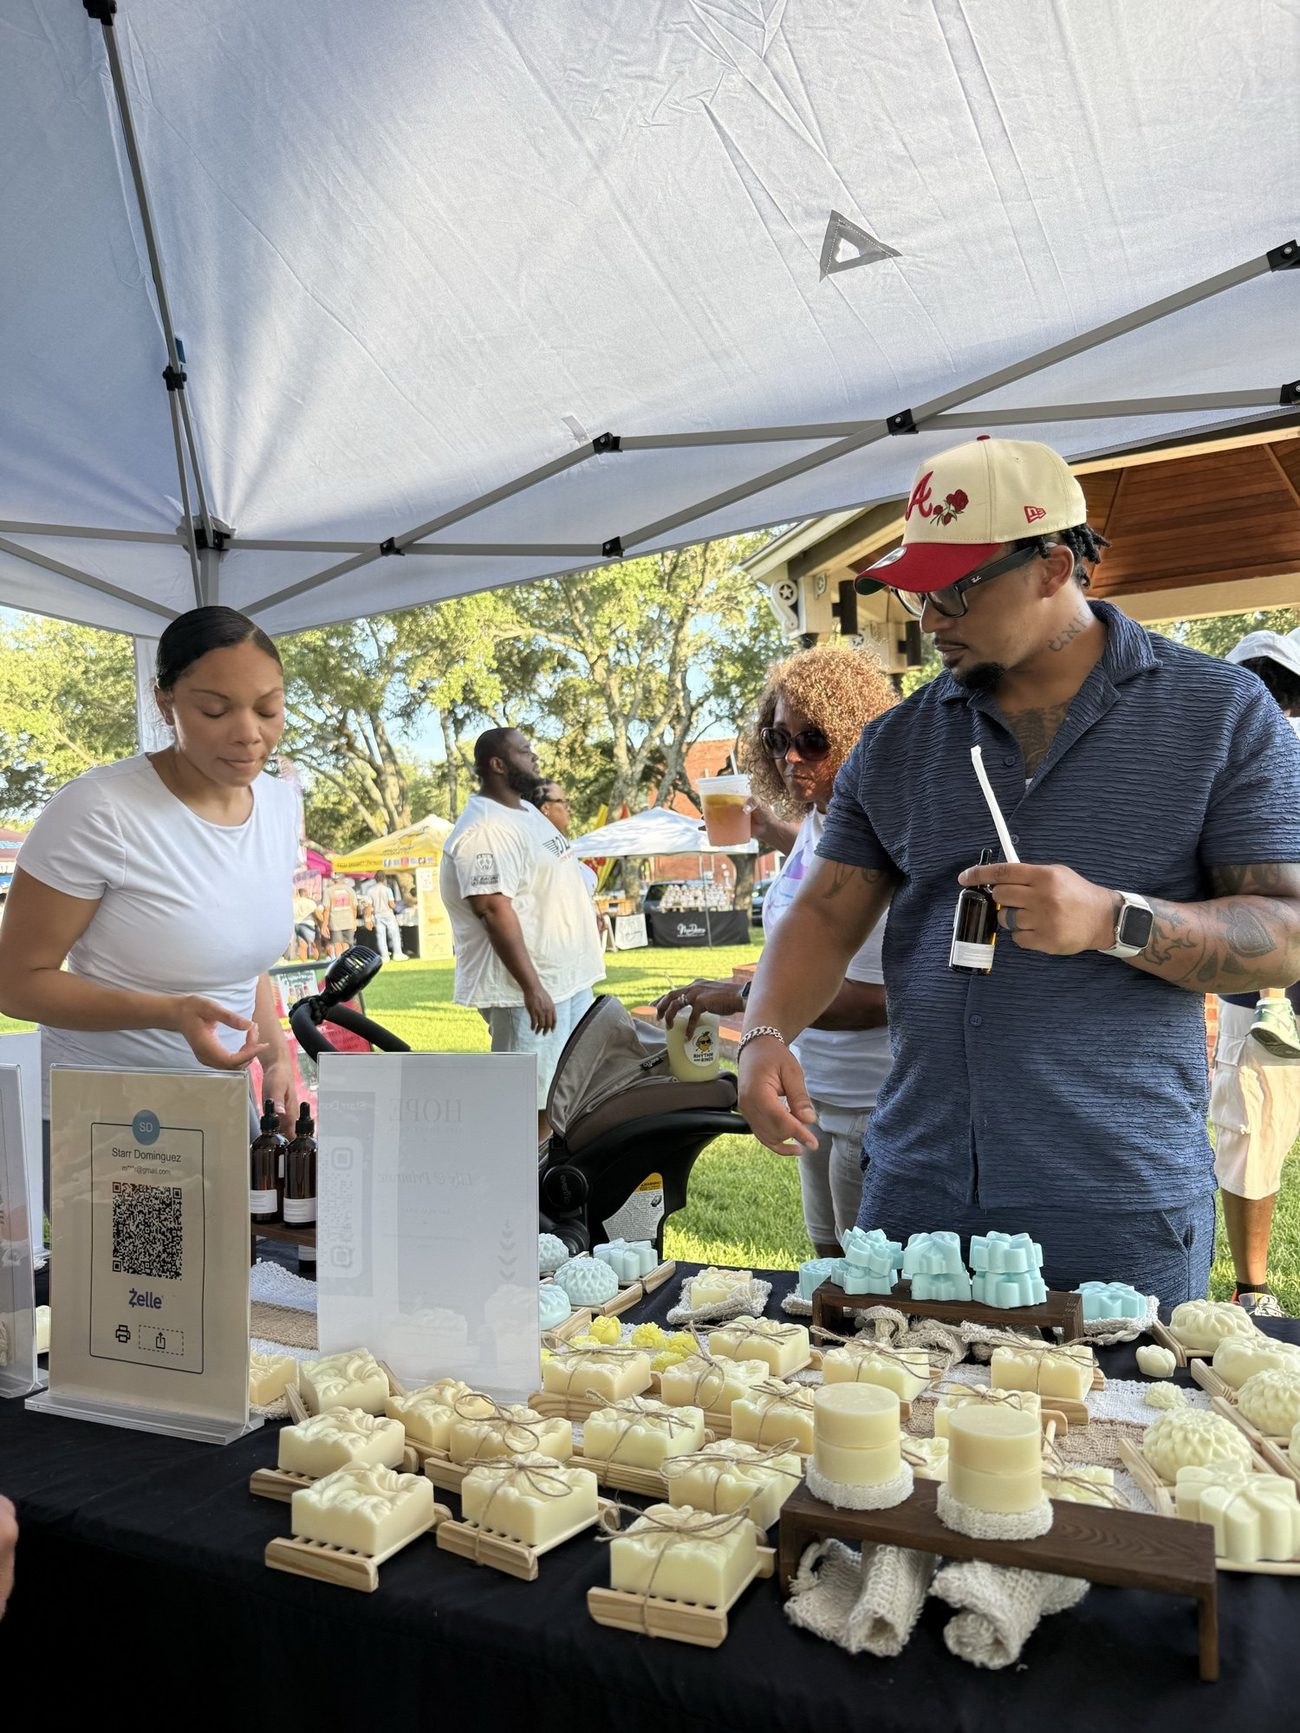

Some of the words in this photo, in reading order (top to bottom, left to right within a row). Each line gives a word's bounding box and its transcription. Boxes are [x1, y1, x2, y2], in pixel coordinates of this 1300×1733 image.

[904, 470, 934, 521] A
[139, 1122, 153, 1133] SD
[111, 1147, 132, 1158] Starr
[134, 1149, 182, 1163] Dominguez
[128, 1288, 162, 1309] Zelle
